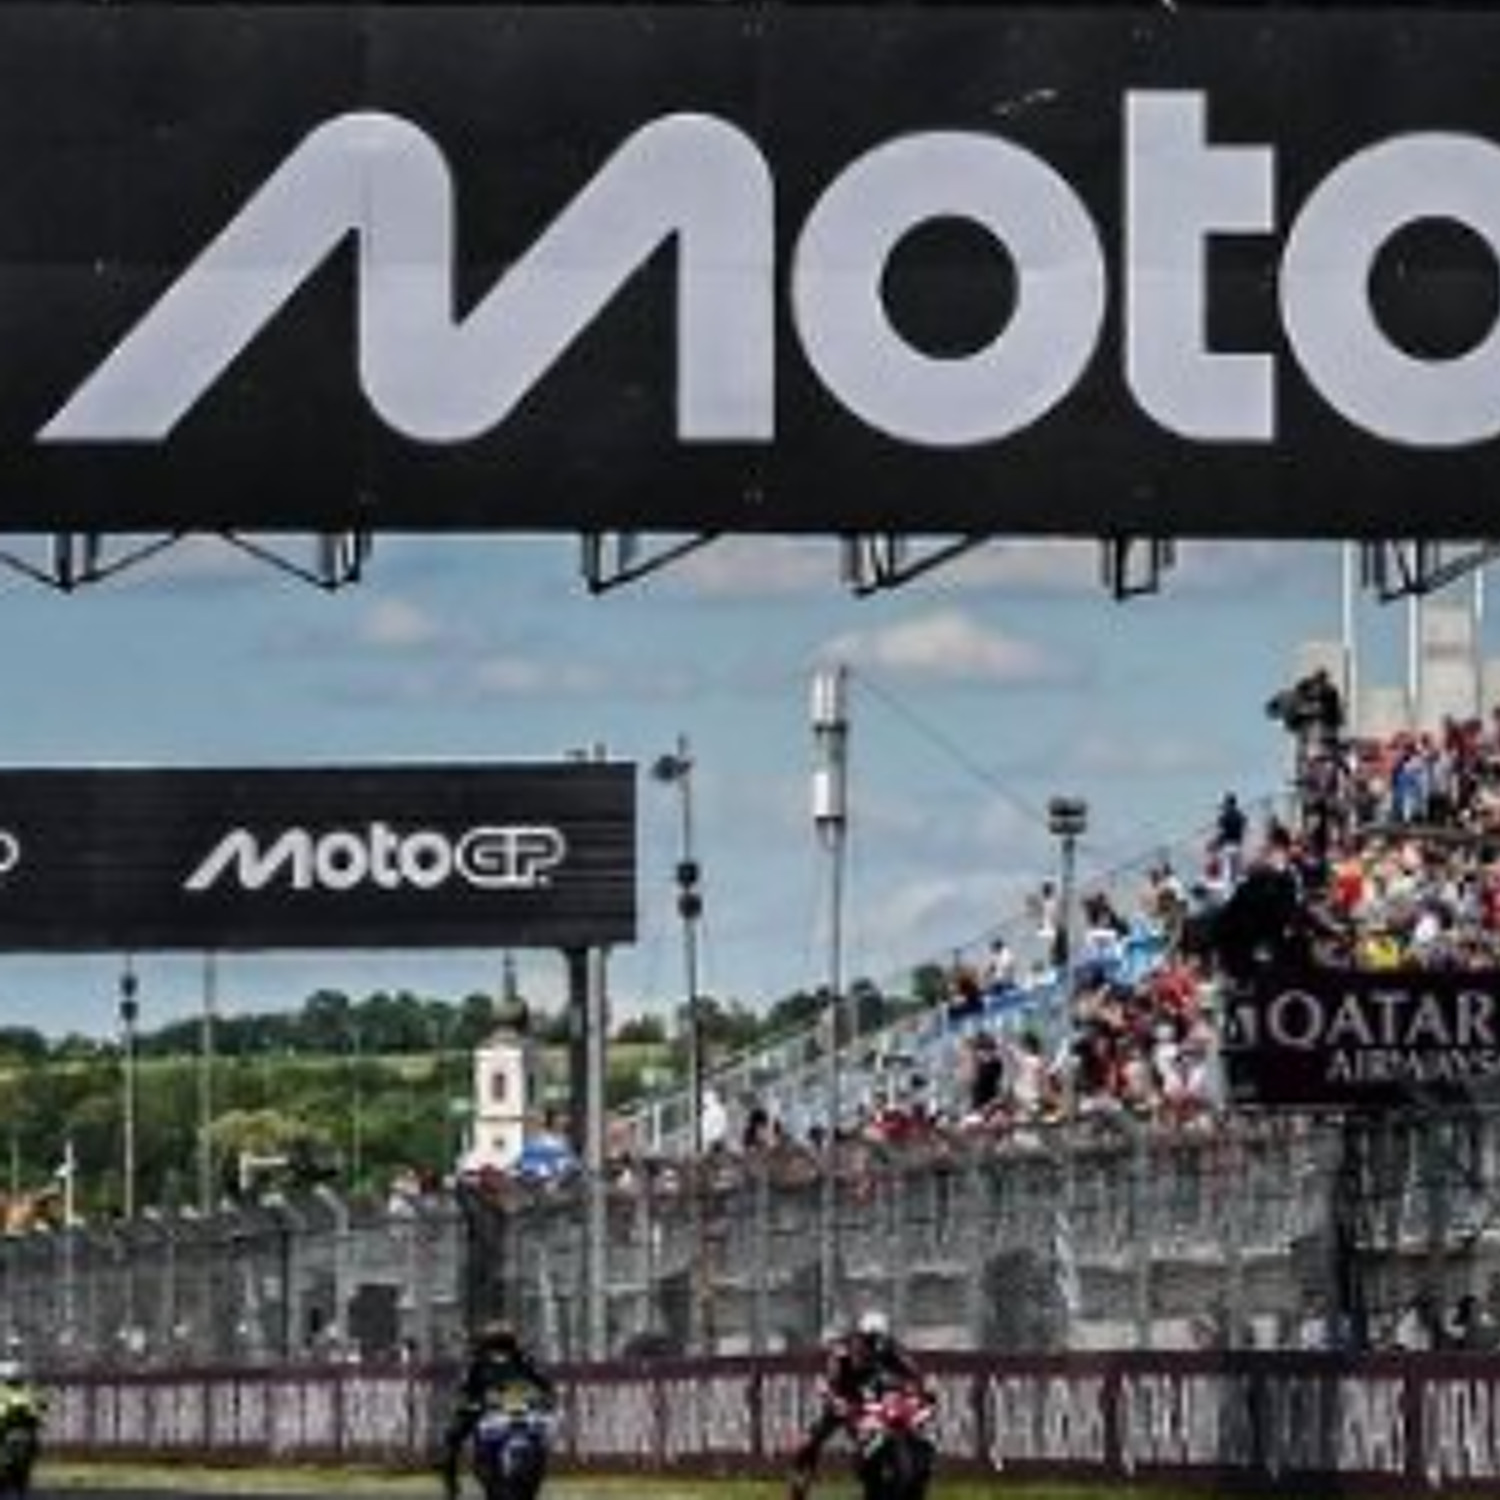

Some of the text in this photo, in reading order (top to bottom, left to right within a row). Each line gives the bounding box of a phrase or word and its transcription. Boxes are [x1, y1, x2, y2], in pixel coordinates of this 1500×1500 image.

[184, 821, 566, 890] MotoGP
[1266, 991, 1499, 1049] QATAR
[1326, 1049, 1499, 1082] AIRWAYS
